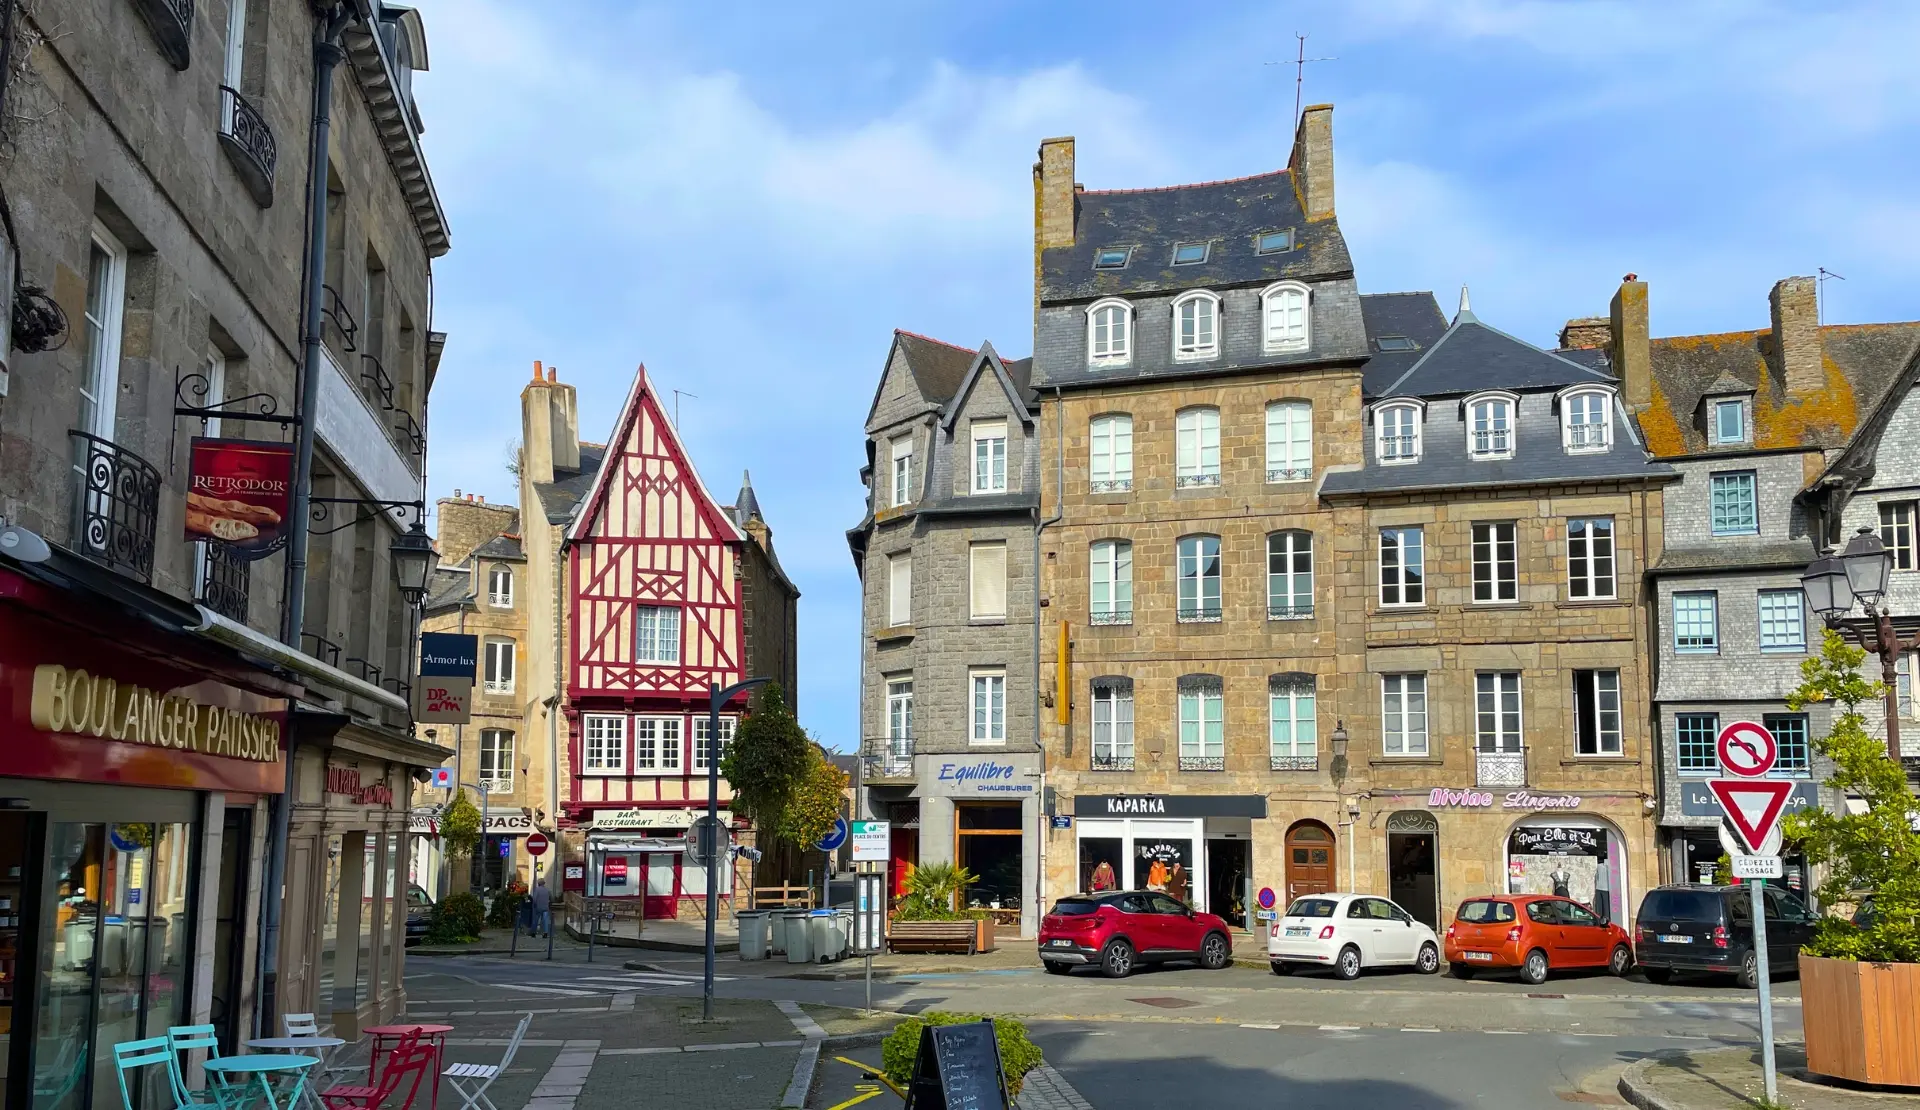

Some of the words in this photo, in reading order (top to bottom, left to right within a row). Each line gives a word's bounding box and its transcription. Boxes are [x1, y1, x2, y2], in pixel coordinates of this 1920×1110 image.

[194, 475, 285, 491] RETRODOR
[424, 653, 457, 665] Armor
[460, 656, 475, 666] lux
[48, 668, 198, 750] BOULANGER
[206, 704, 280, 763] PATISSIER
[938, 762, 1014, 785] Equilibre
[1107, 798, 1165, 813] KAPARKA
[1428, 788, 1493, 807] Divine
[1502, 791, 1581, 810] Lingerie
[1692, 793, 1707, 804] Le
[1518, 833, 1541, 846] Pour
[1543, 828, 1567, 842] Elle
[1145, 844, 1181, 859] KAPARKA
